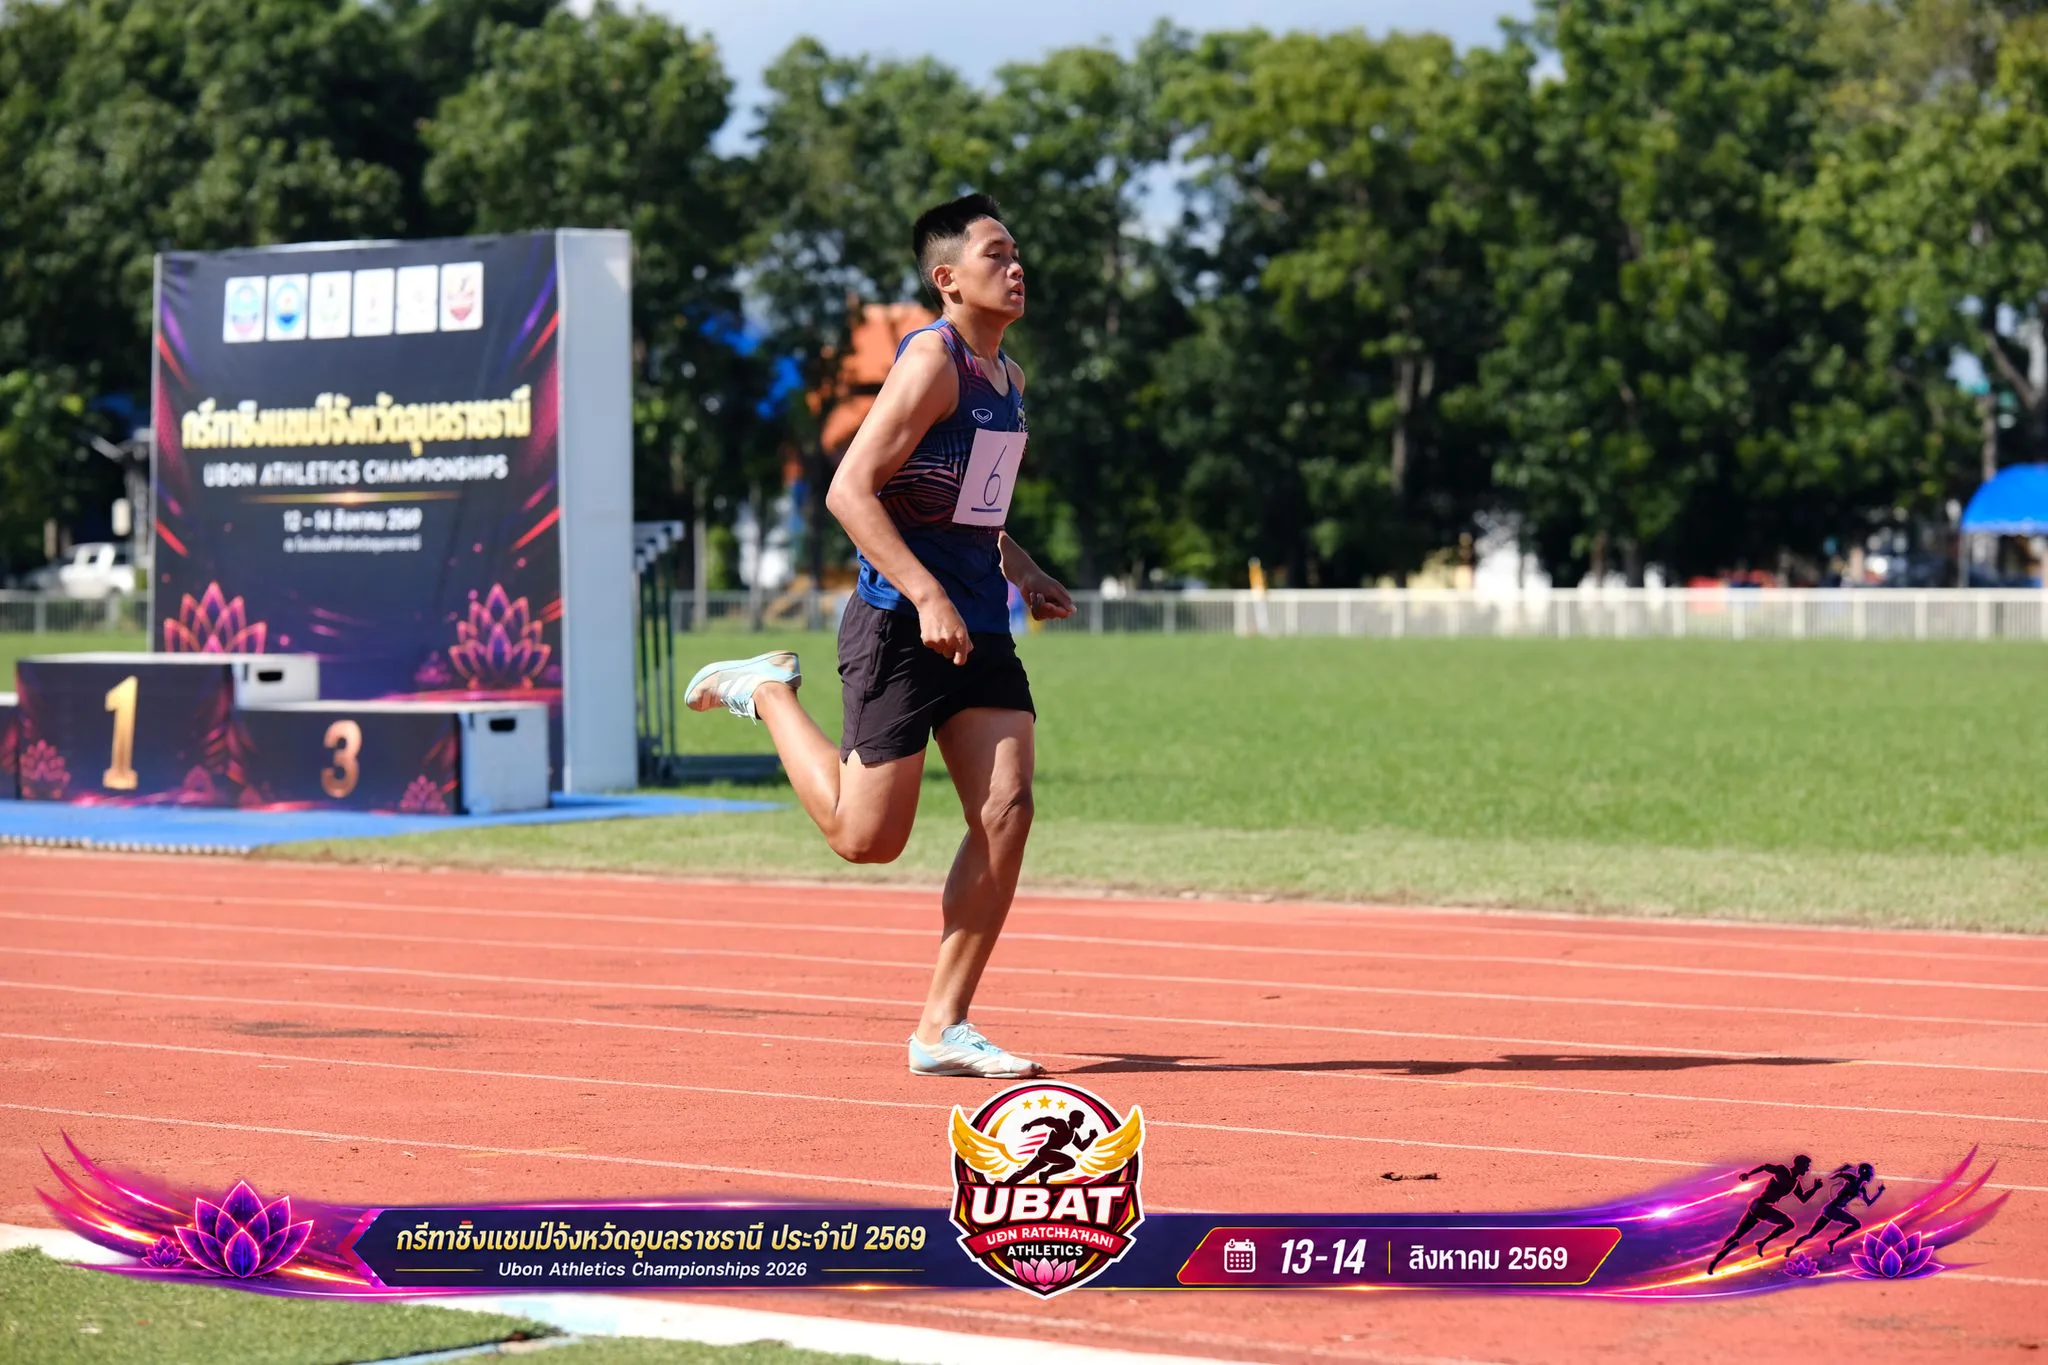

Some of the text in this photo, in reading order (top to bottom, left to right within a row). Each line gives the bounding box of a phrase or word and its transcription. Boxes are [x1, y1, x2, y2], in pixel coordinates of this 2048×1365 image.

[203, 455, 509, 487] UBON ATHLETICS CHAMPIONSHIPS
[983, 444, 1008, 506] 6
[102, 675, 139, 790] 1
[321, 719, 363, 799] 3
